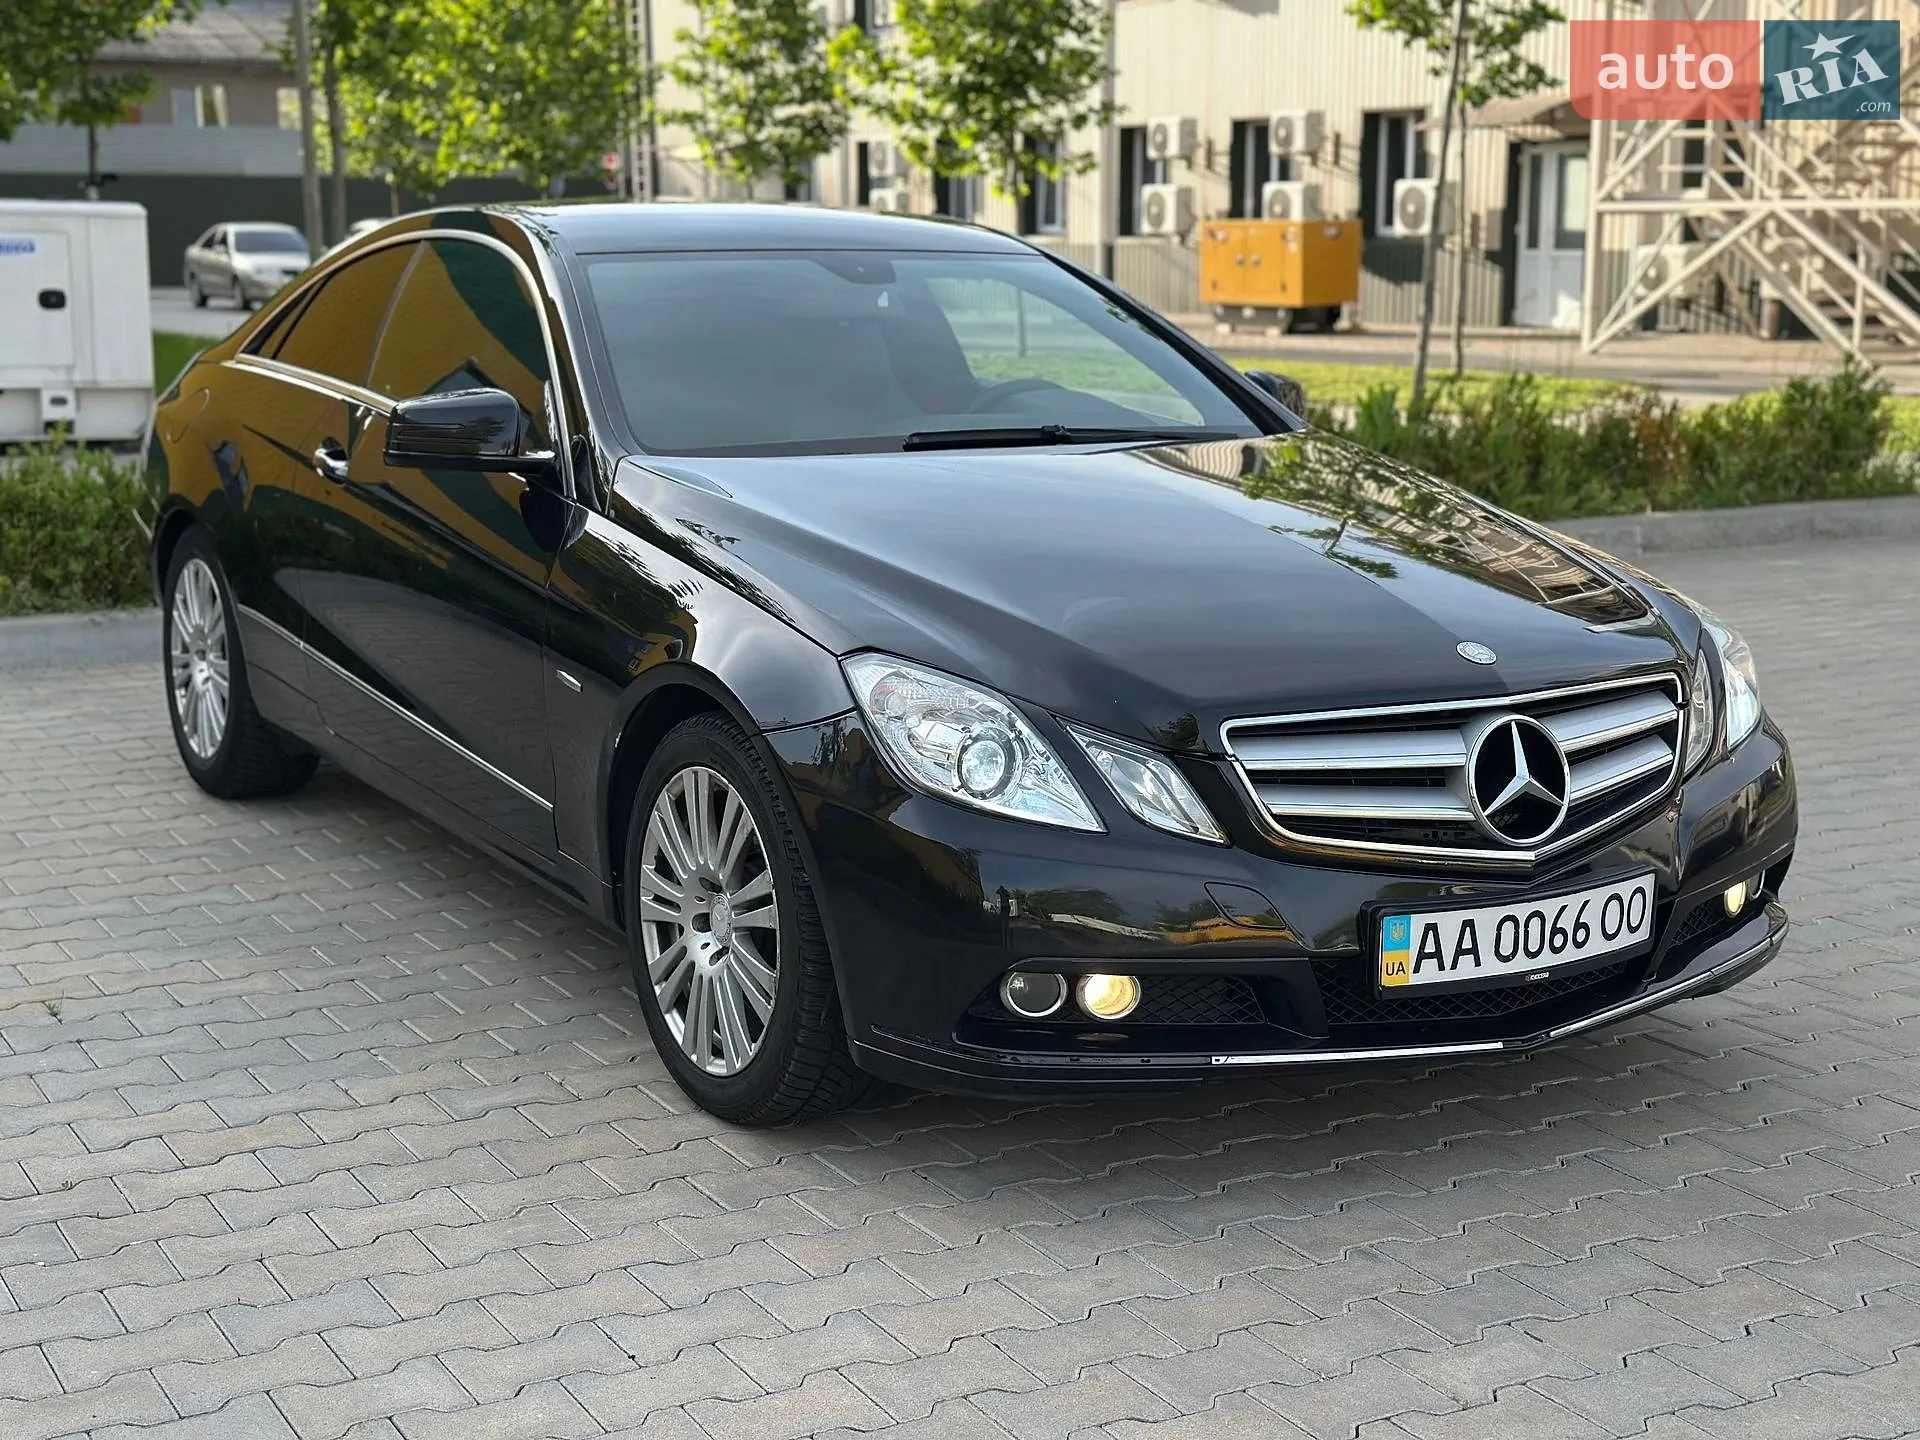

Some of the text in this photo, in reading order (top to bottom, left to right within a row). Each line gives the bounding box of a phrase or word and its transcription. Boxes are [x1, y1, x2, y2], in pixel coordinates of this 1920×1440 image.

[1412, 918, 1482, 974] AA
[1494, 899, 1591, 964] 0066
[1386, 961, 1406, 977] UA
